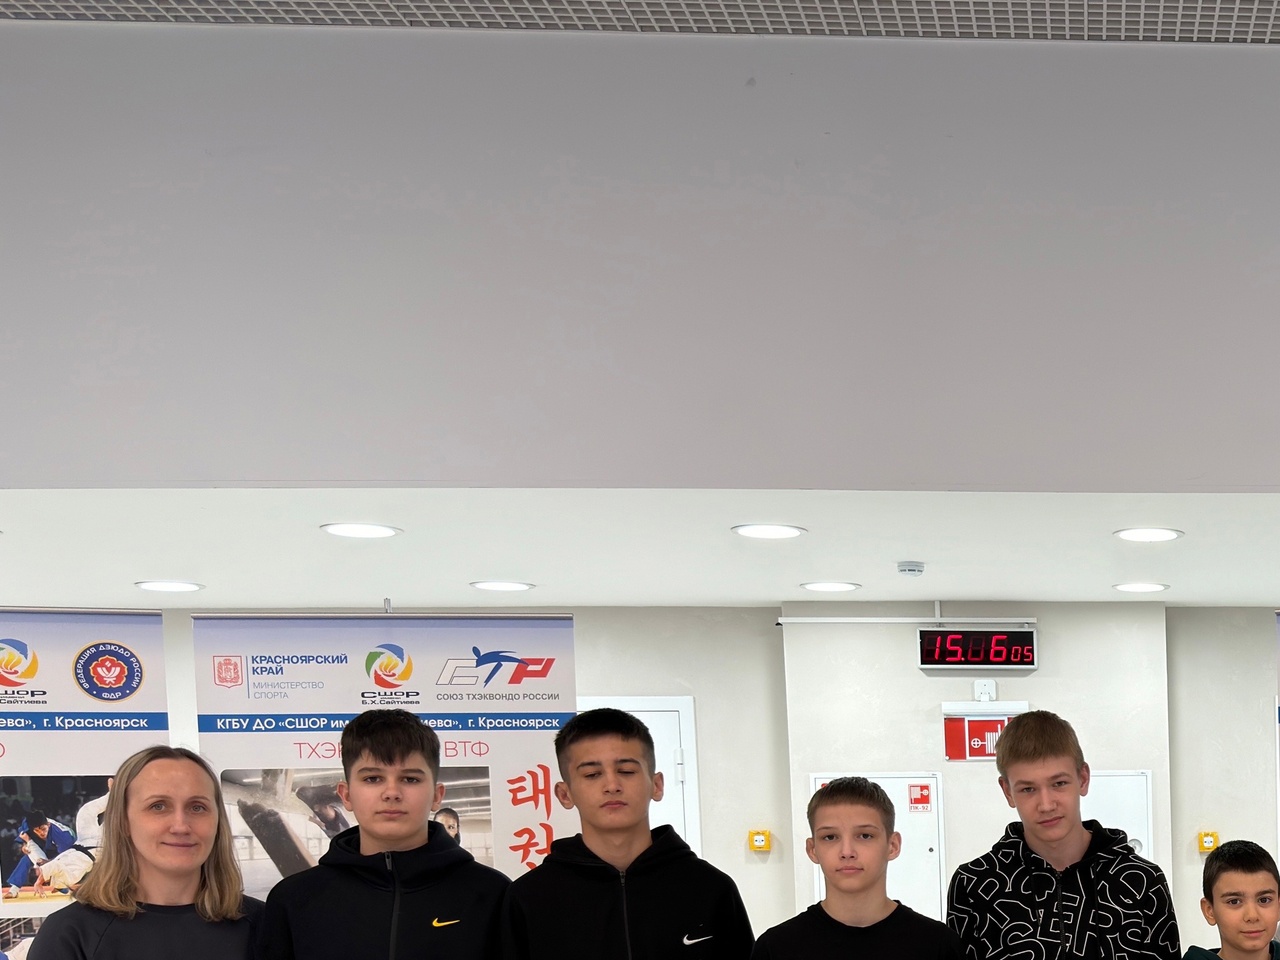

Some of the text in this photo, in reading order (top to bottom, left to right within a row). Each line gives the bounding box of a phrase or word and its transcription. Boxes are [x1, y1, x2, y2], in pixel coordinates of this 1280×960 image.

[251, 653, 348, 664] КРАСНОЯРСКИЙ
[76, 644, 142, 689] ФЕДЕРАЦИЯ ДЗЮДО РОССИИ
[252, 666, 284, 676] КРАЙ
[253, 681, 325, 690] МИНИСТЕРСТВО
[102, 691, 122, 699] ФДР
[254, 691, 289, 699] СПОРТА
[436, 693, 560, 701] СОЮЗ ТХЭКВОНДО РОССИИ
[43, 717, 52, 727] г.
[55, 716, 149, 729] Красноярск
[217, 718, 250, 730] КГБУ
[252, 718, 276, 730] ДО
[278, 718, 328, 729] «СШОР
[468, 718, 475, 727] г.
[478, 716, 560, 730] Красноярск
[444, 740, 490, 757] ВТФ
